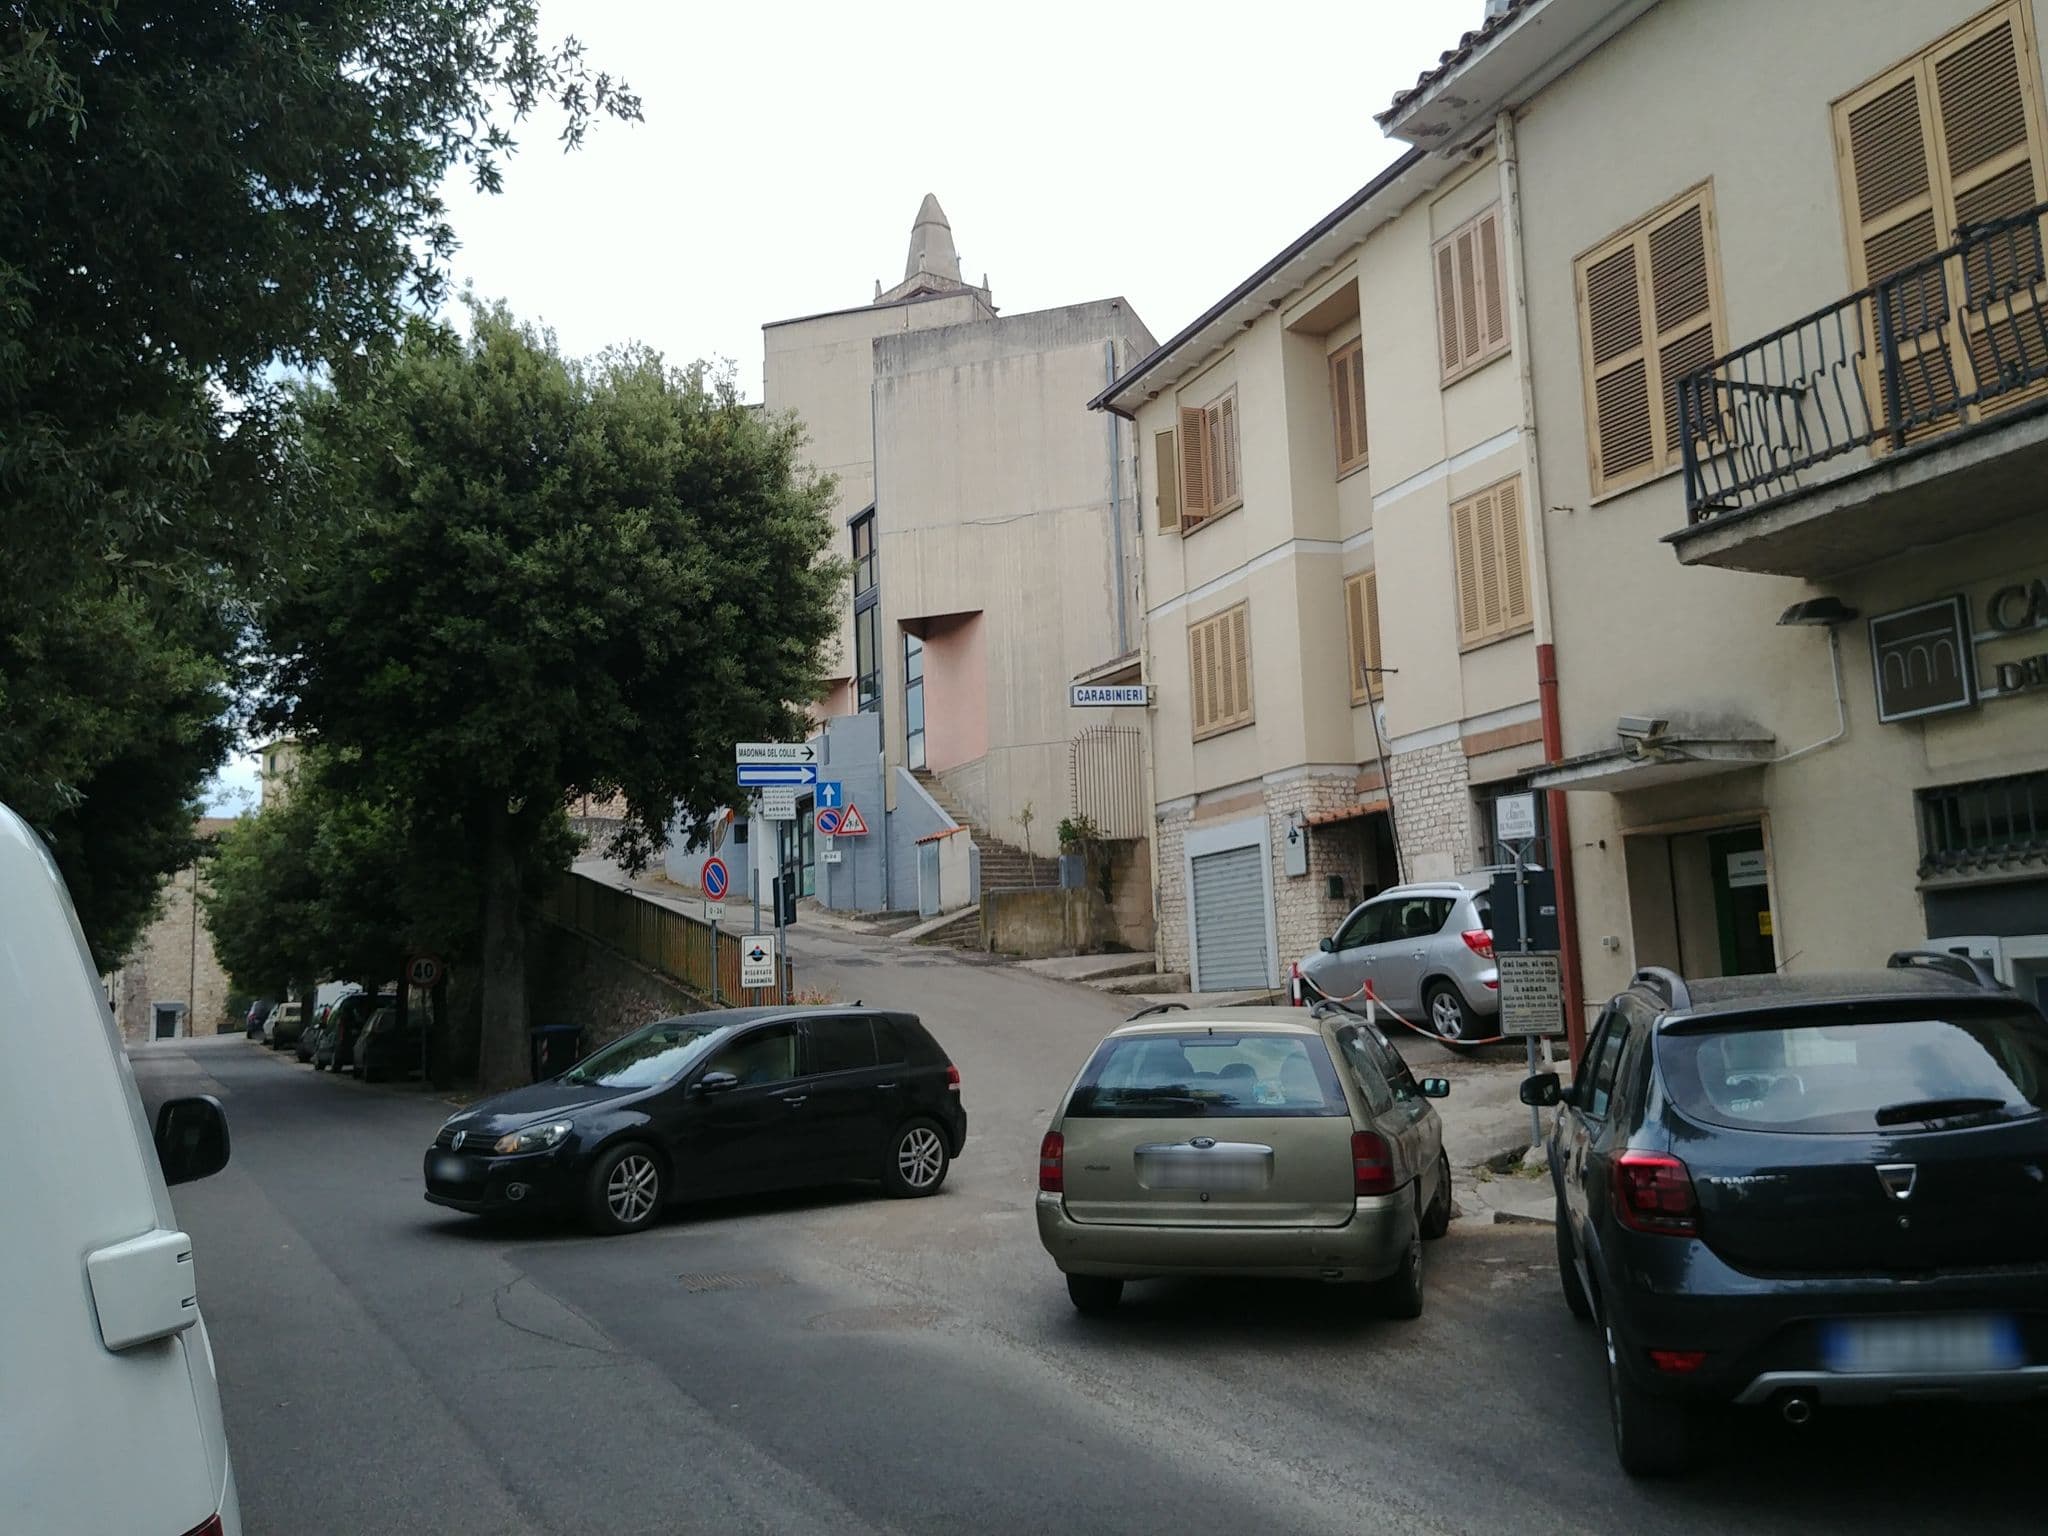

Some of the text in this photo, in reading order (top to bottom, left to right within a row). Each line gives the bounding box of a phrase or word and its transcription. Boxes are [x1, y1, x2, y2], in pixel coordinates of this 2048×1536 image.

[1077, 689, 1143, 702] CARABINIERI
[738, 747, 797, 758] MADONNA DEL COLLE
[414, 963, 434, 978] 40
